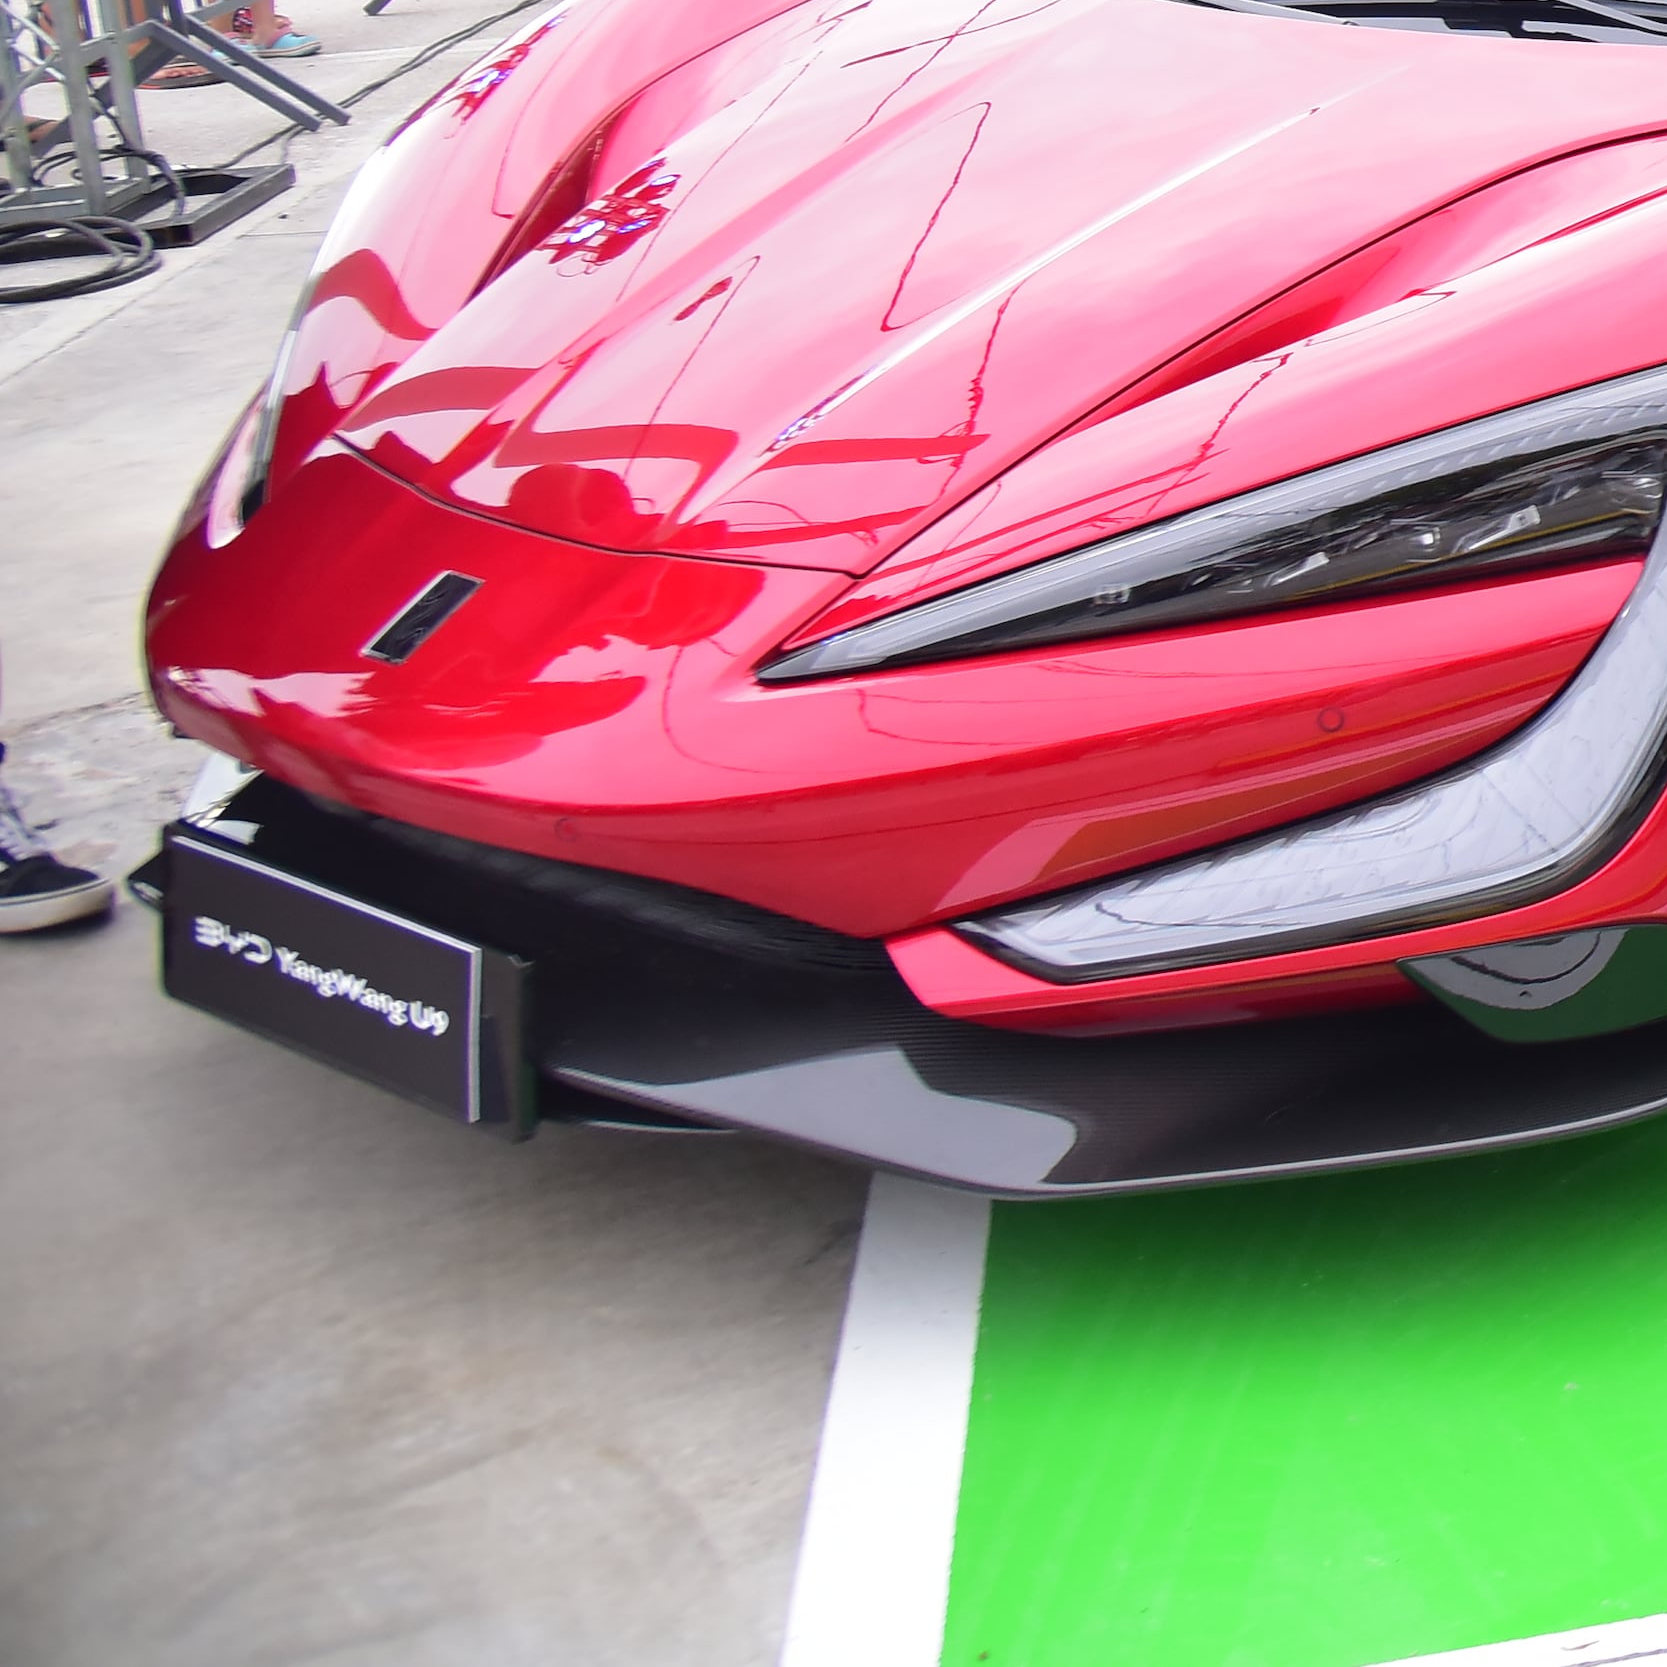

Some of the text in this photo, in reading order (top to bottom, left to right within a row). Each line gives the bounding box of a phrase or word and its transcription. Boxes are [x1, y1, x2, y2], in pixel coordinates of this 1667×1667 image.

[194, 915, 451, 1037] BYD YangWang U9
